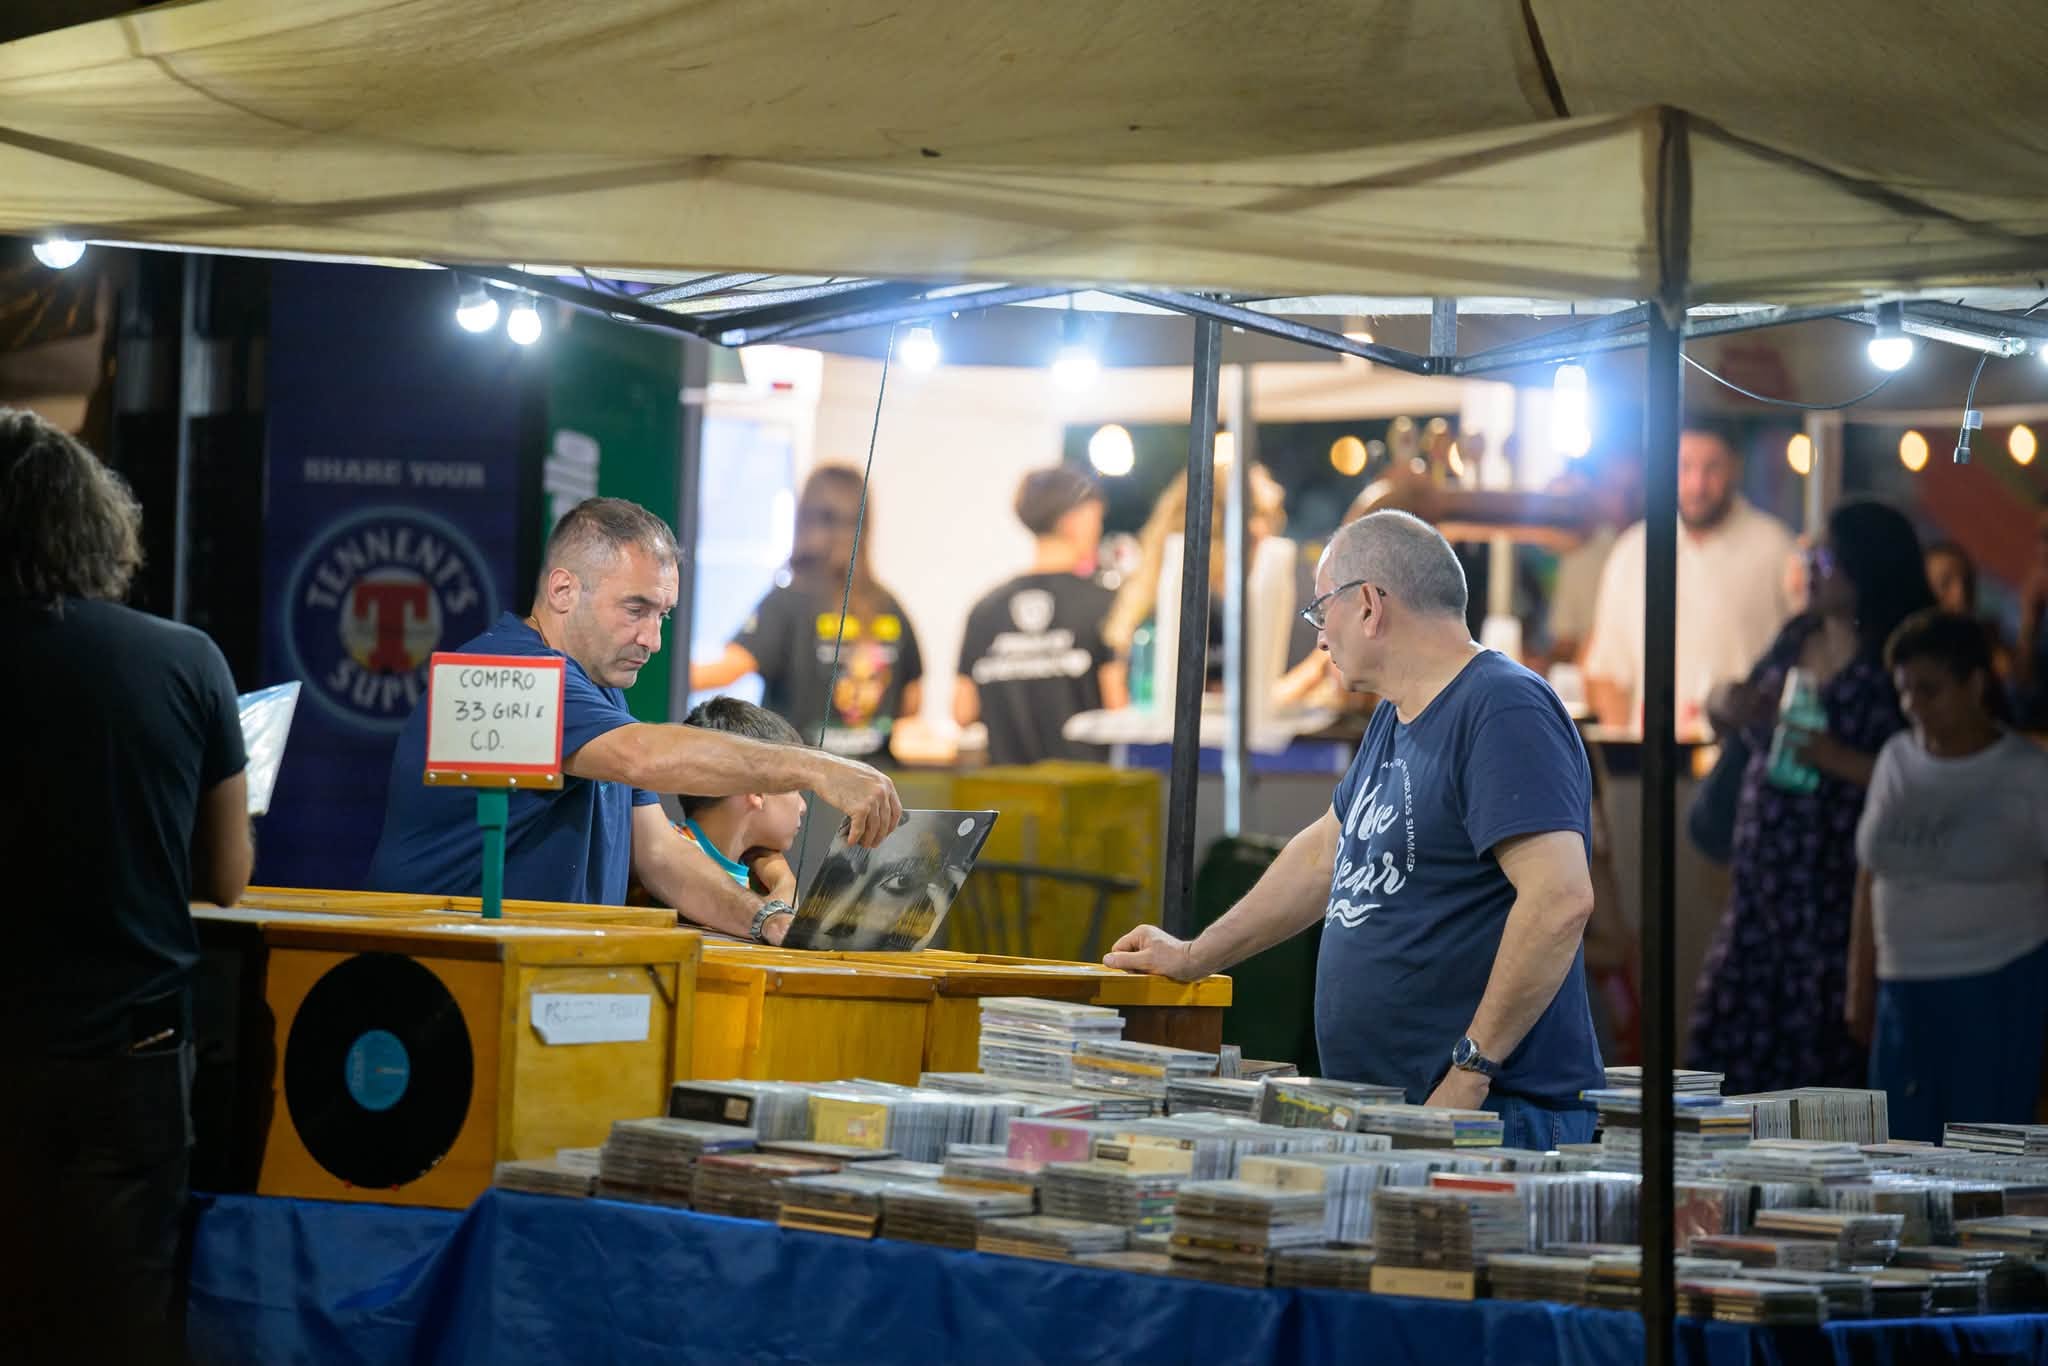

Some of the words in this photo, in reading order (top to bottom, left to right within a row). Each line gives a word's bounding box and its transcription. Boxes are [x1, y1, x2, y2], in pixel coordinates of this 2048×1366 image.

[409, 459, 486, 488] YOUR
[354, 580, 432, 672] T
[459, 668, 536, 691] COMPRO
[454, 699, 487, 722] 33
[492, 702, 531, 720] GIRI
